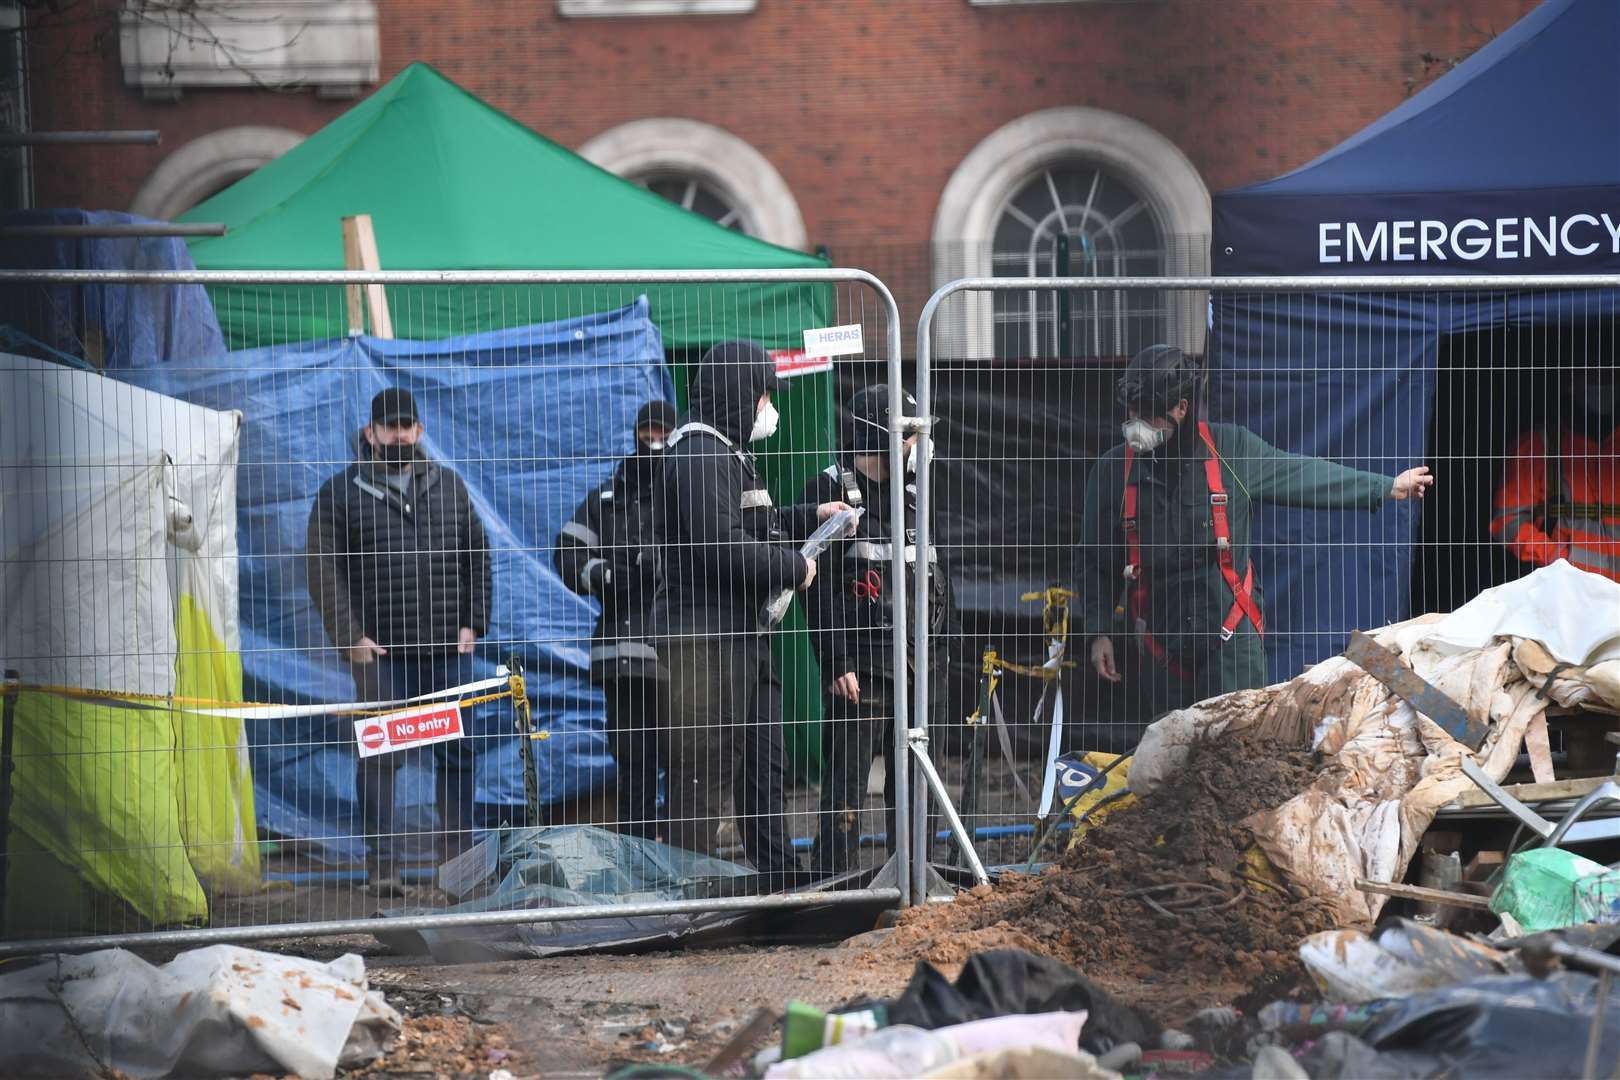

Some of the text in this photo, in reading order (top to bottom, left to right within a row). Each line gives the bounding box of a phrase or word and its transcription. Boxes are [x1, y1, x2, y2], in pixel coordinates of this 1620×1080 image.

[1319, 213, 1620, 263] EMERGENCY
[819, 329, 860, 343] HERAS
[396, 716, 450, 736] No entry
